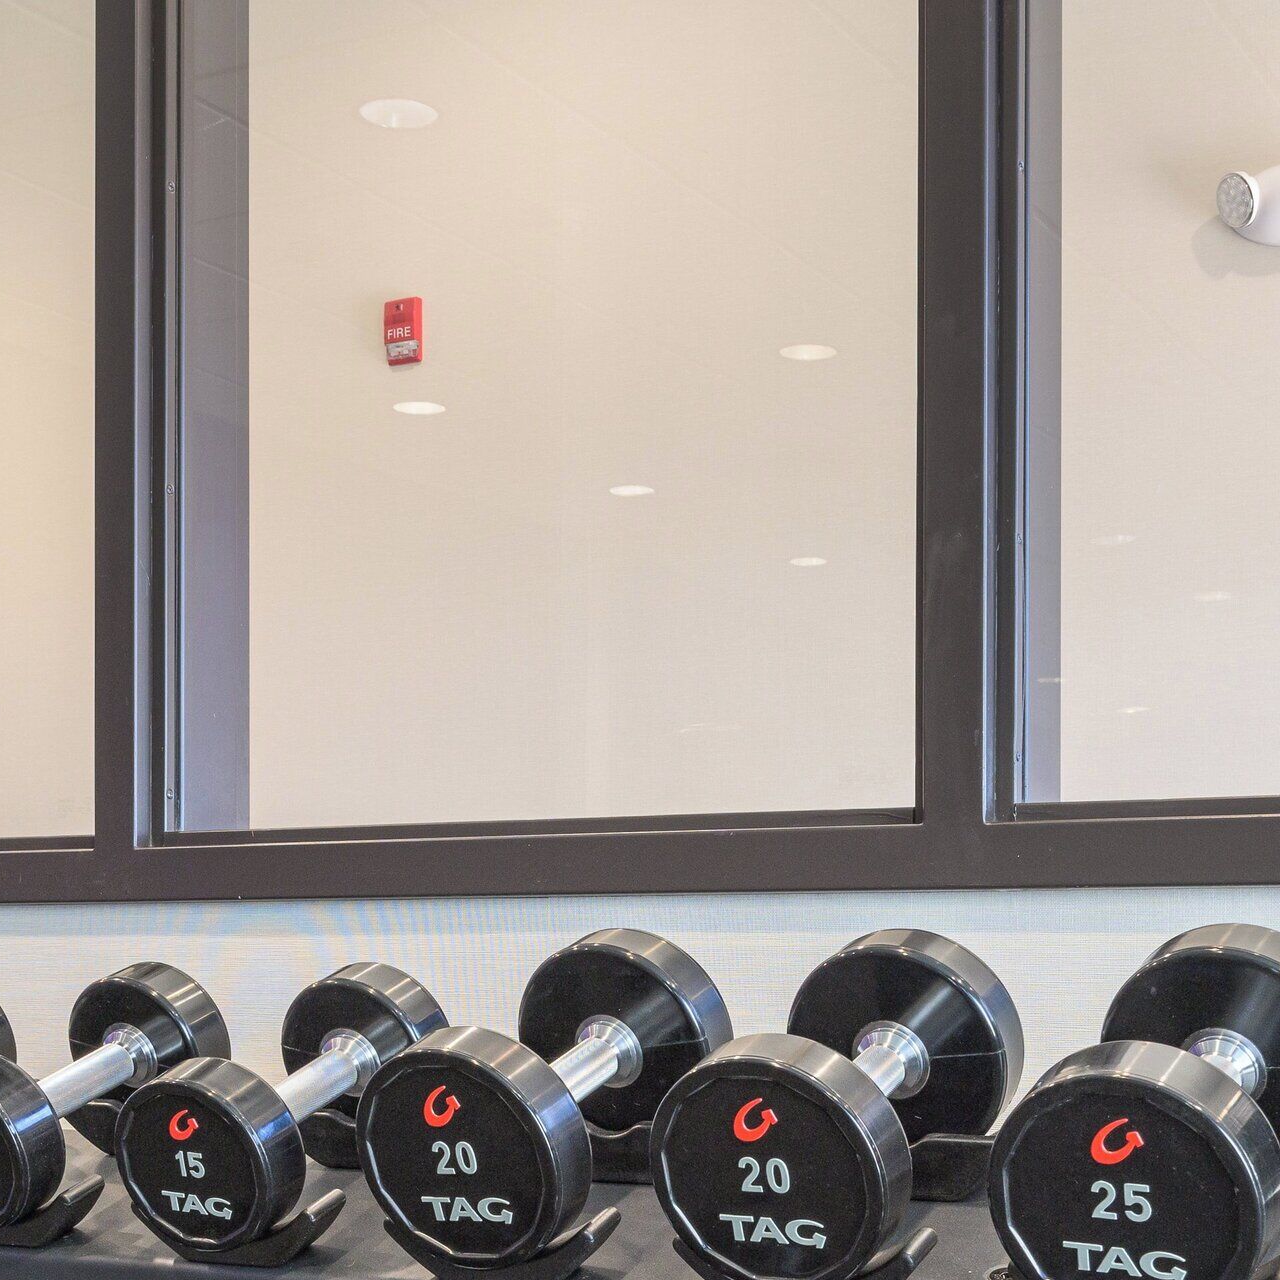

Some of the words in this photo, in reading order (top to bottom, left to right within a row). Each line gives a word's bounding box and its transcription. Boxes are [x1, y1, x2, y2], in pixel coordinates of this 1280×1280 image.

[387, 326, 411, 339] FIRE
[174, 1150, 206, 1179] 15
[431, 1140, 478, 1175] 20
[737, 1156, 791, 1195] 20
[161, 1190, 233, 1221] TAG
[420, 1195, 514, 1225] TAG
[1090, 1179, 1153, 1223] 25
[718, 1212, 827, 1250] TAG
